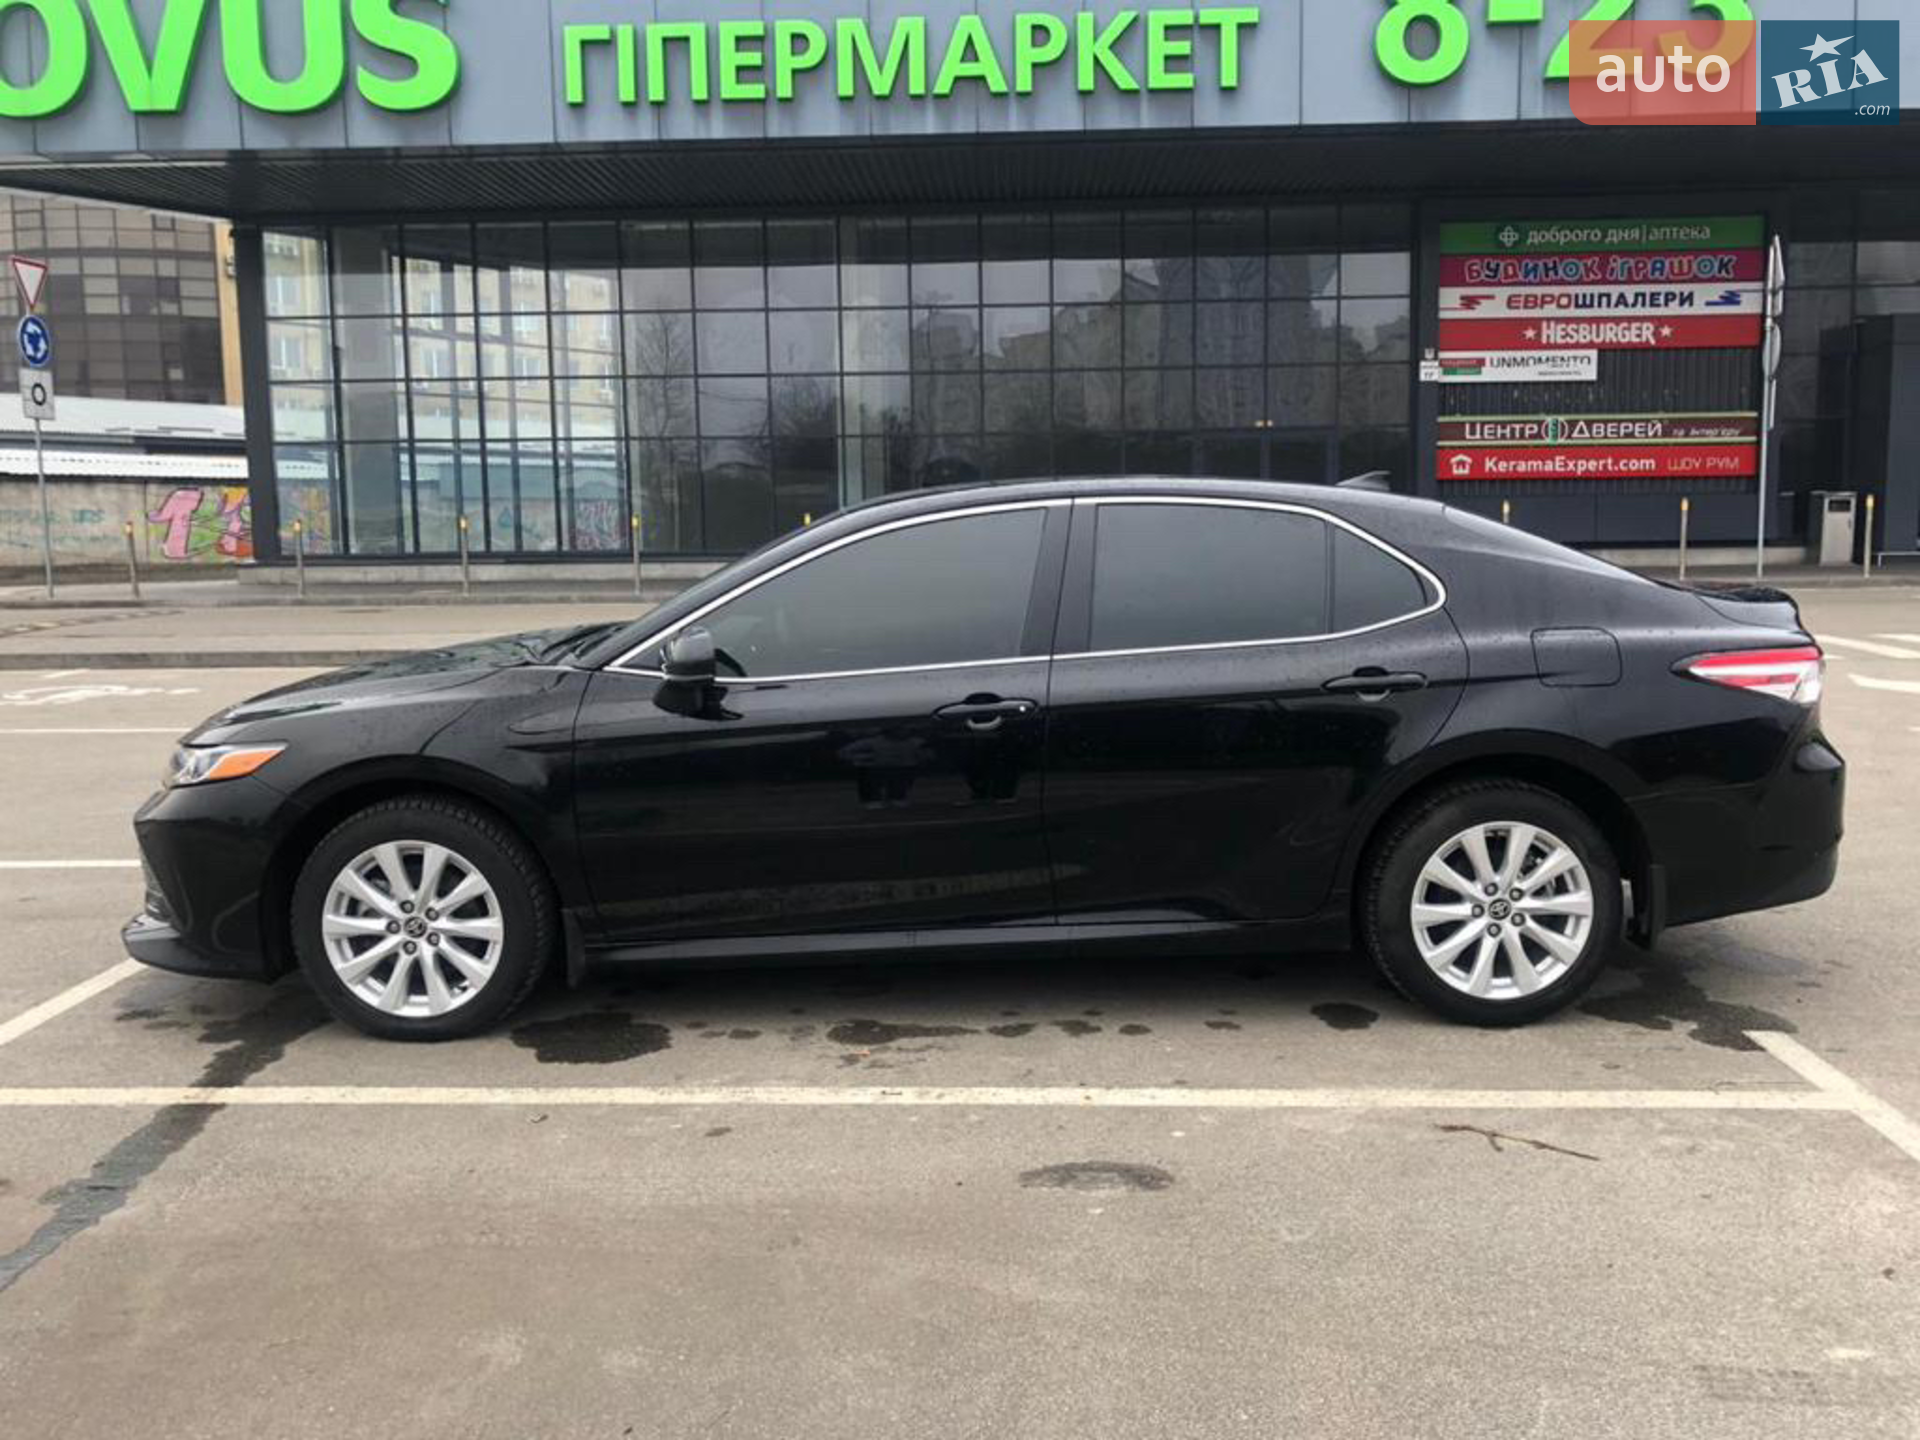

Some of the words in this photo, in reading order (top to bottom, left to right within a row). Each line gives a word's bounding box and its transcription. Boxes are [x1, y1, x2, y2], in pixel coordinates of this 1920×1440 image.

[563, 7, 1259, 104] ГІПЕРМАРКЕТ
[1527, 226, 1601, 245] доброго
[1465, 257, 1602, 283] БУДИНОК
[1506, 291, 1695, 310] ЄВРОШПАЛЕРИ
[1541, 320, 1656, 345] HESBURGER
[1464, 421, 1539, 440] ЦЕНТР
[1571, 419, 1663, 438] ДВЕРЕЙ
[1484, 455, 1656, 475] KeramaExpert.com
[1668, 457, 1702, 470] ШОУ
[1706, 456, 1740, 470] РУМ
